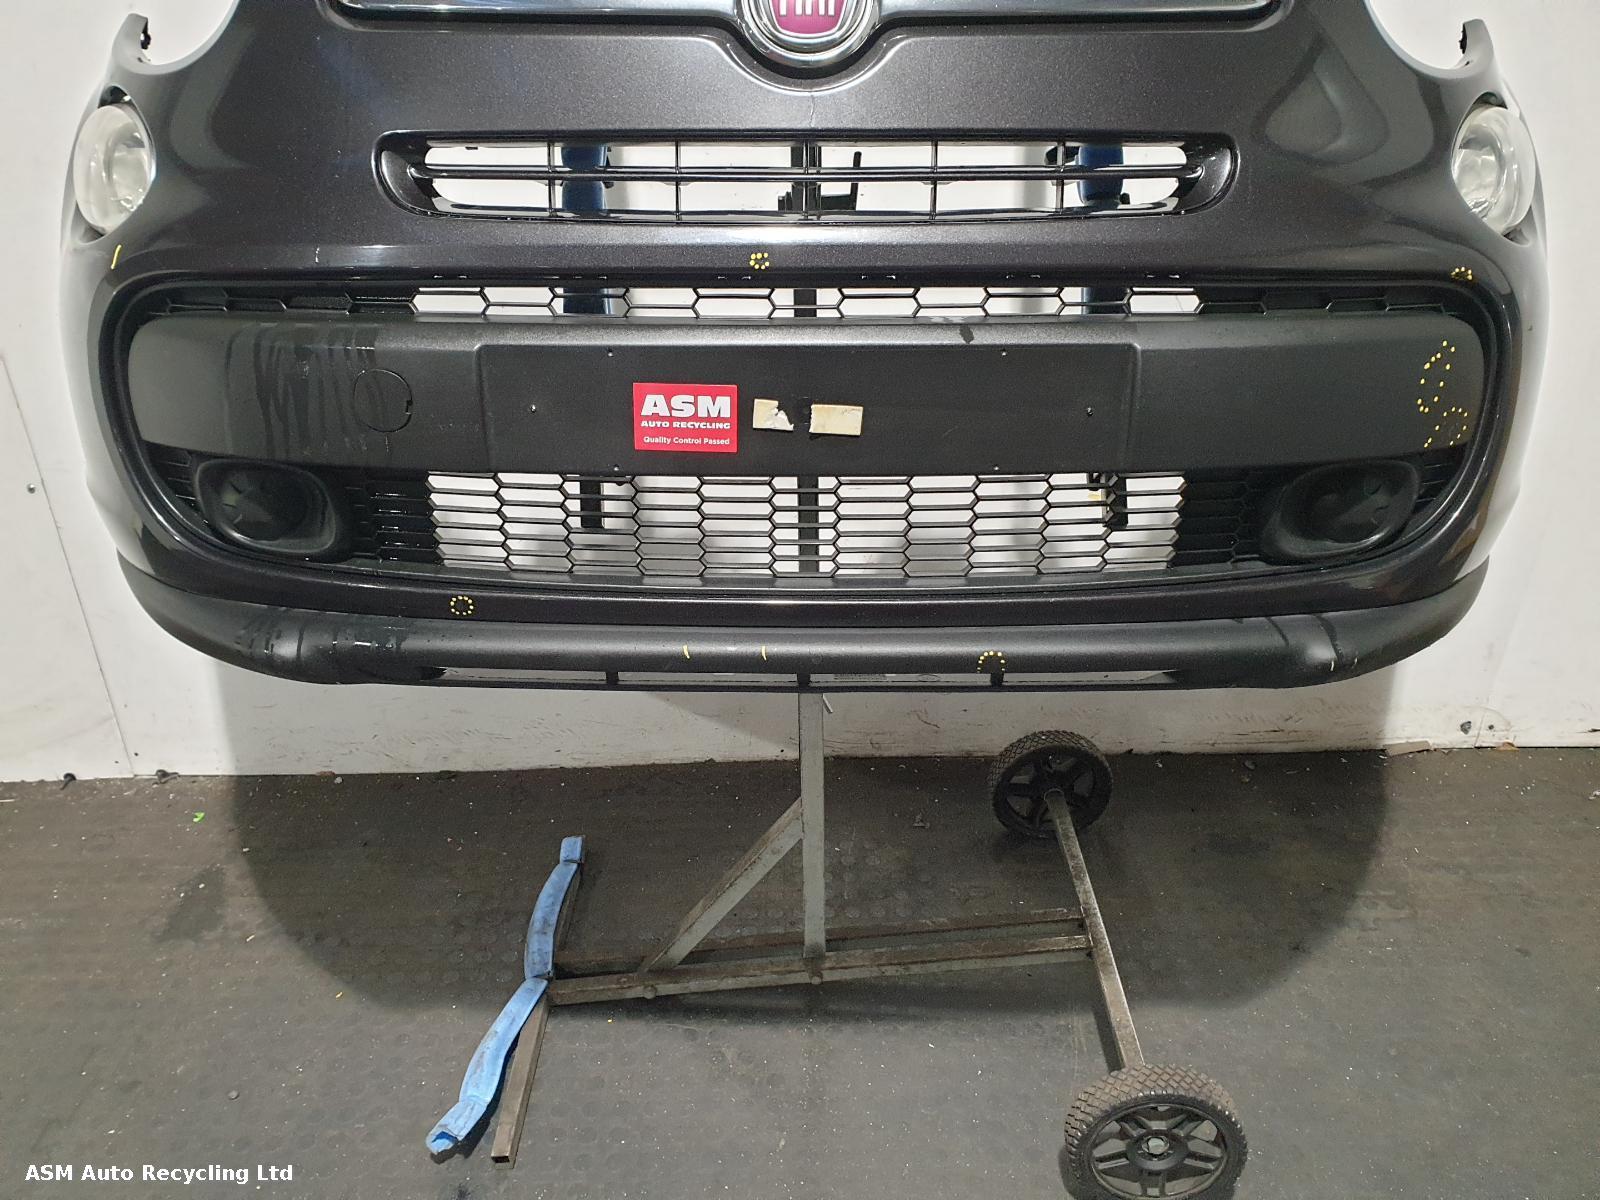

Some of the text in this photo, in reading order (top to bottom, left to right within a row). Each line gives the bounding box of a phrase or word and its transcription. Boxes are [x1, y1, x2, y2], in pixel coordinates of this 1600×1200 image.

[641, 394, 731, 418] ASM
[641, 420, 731, 430] AUTO RECYCLING
[643, 436, 671, 445] Quality
[673, 437, 702, 445] Control
